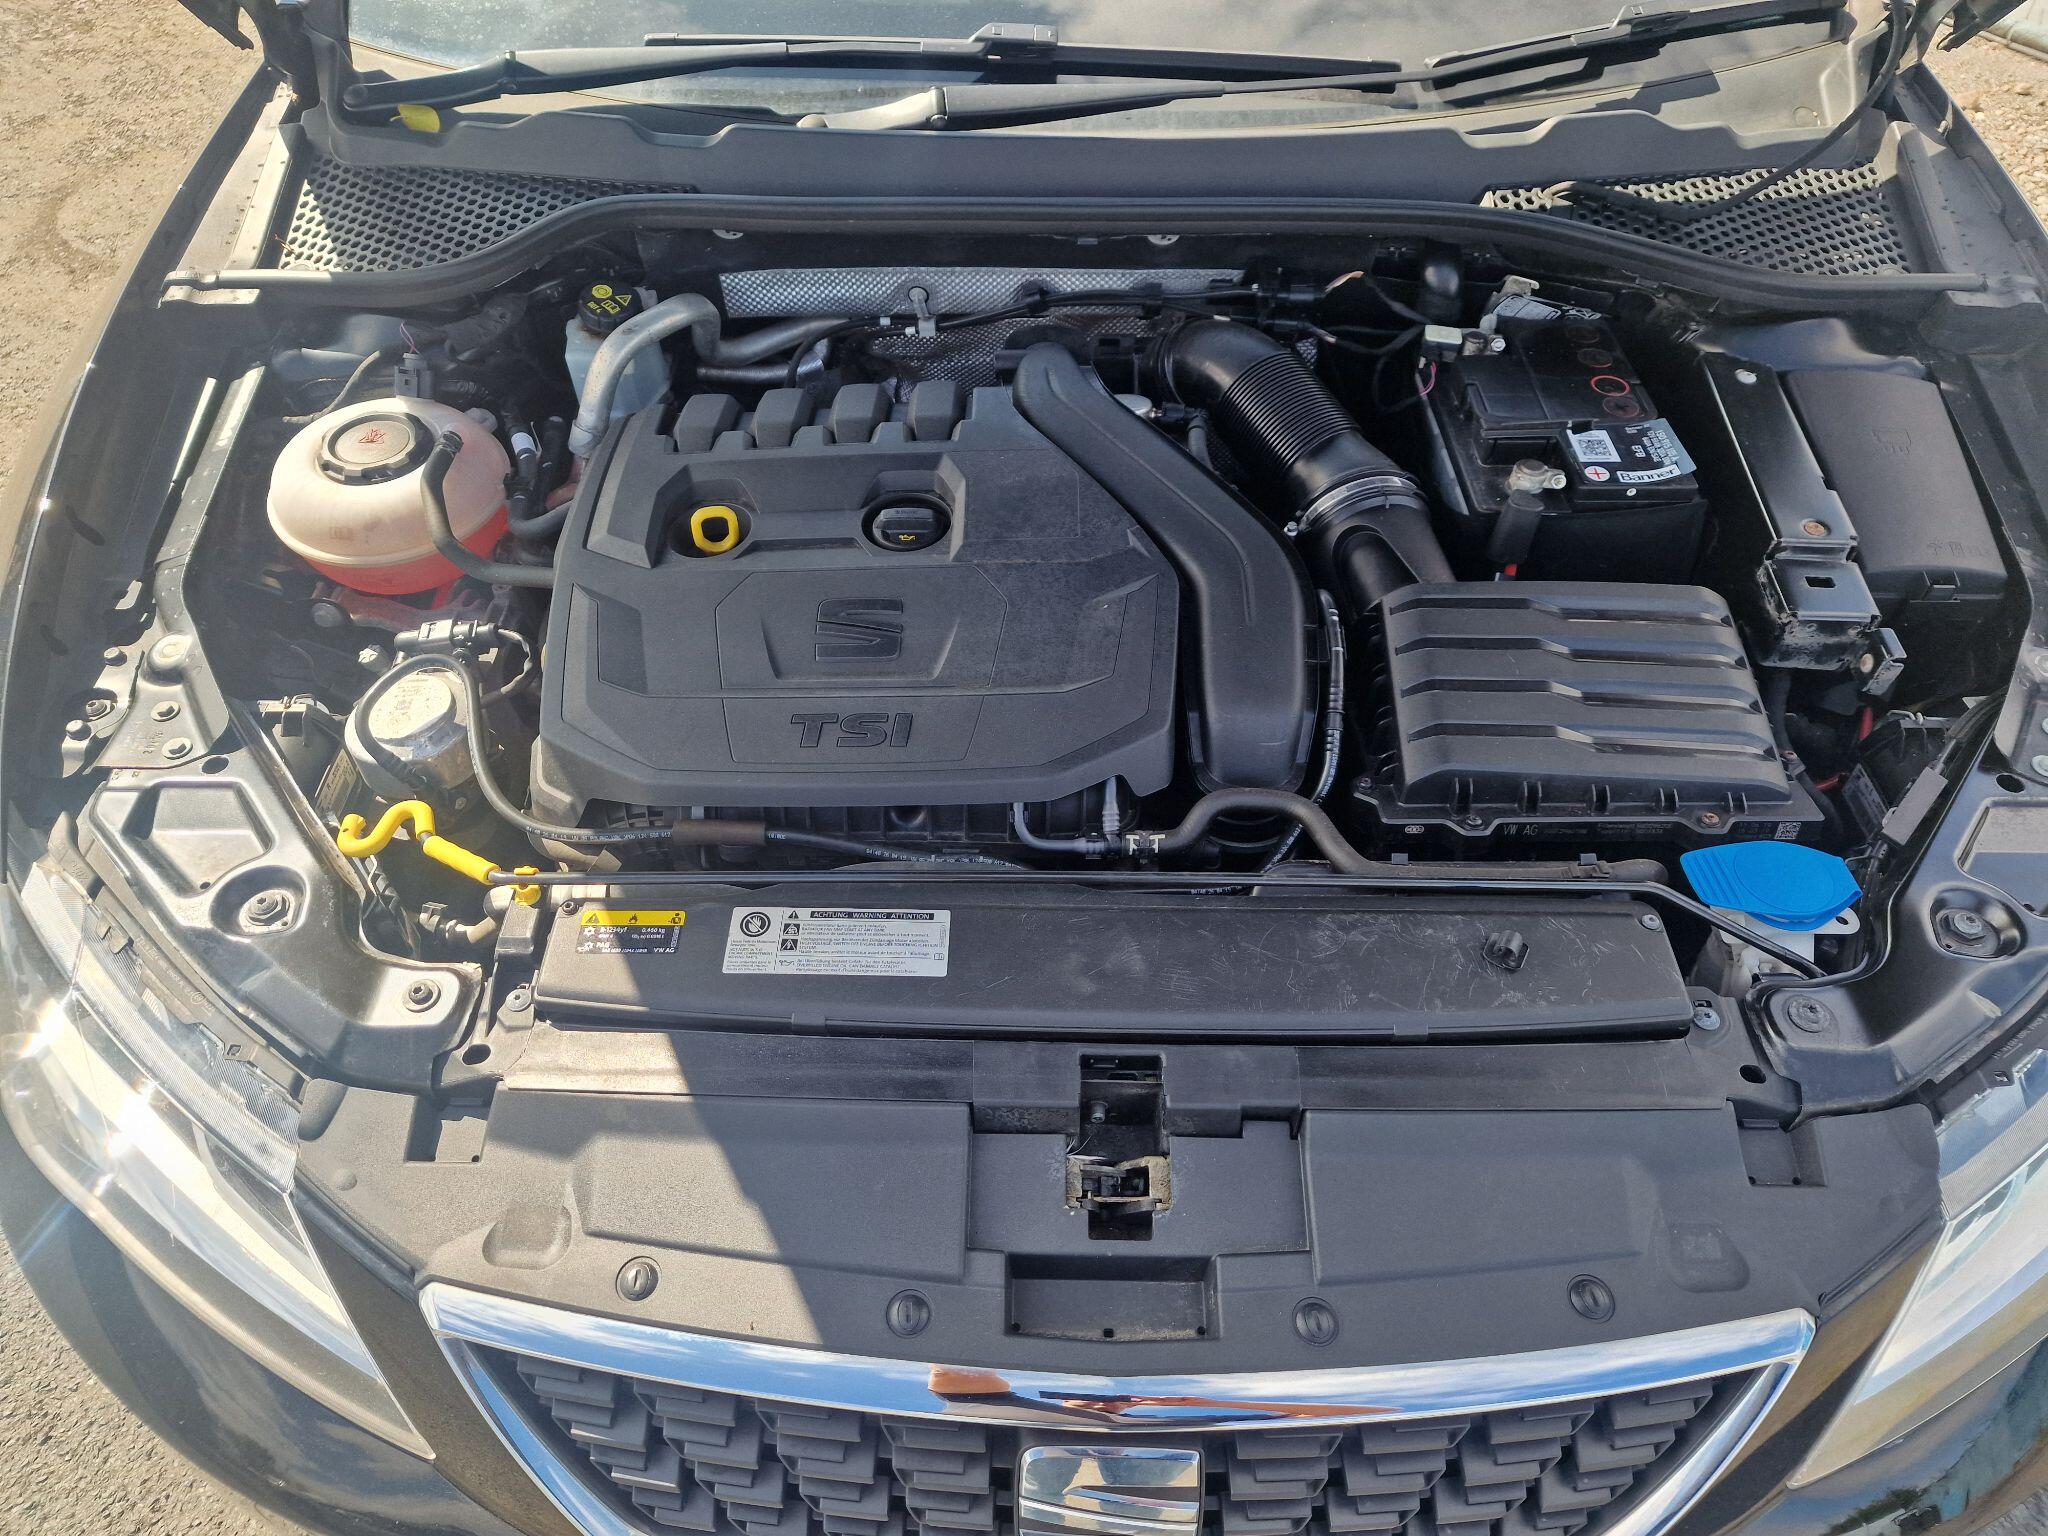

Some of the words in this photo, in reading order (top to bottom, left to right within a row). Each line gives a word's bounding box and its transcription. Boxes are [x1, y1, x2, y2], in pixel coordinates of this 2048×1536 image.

[1632, 445, 1646, 458] EFB
[1620, 468, 1676, 482] Banner
[791, 713, 914, 748] TSI
[1503, 824, 1518, 835] VW
[1523, 824, 1538, 835] AG
